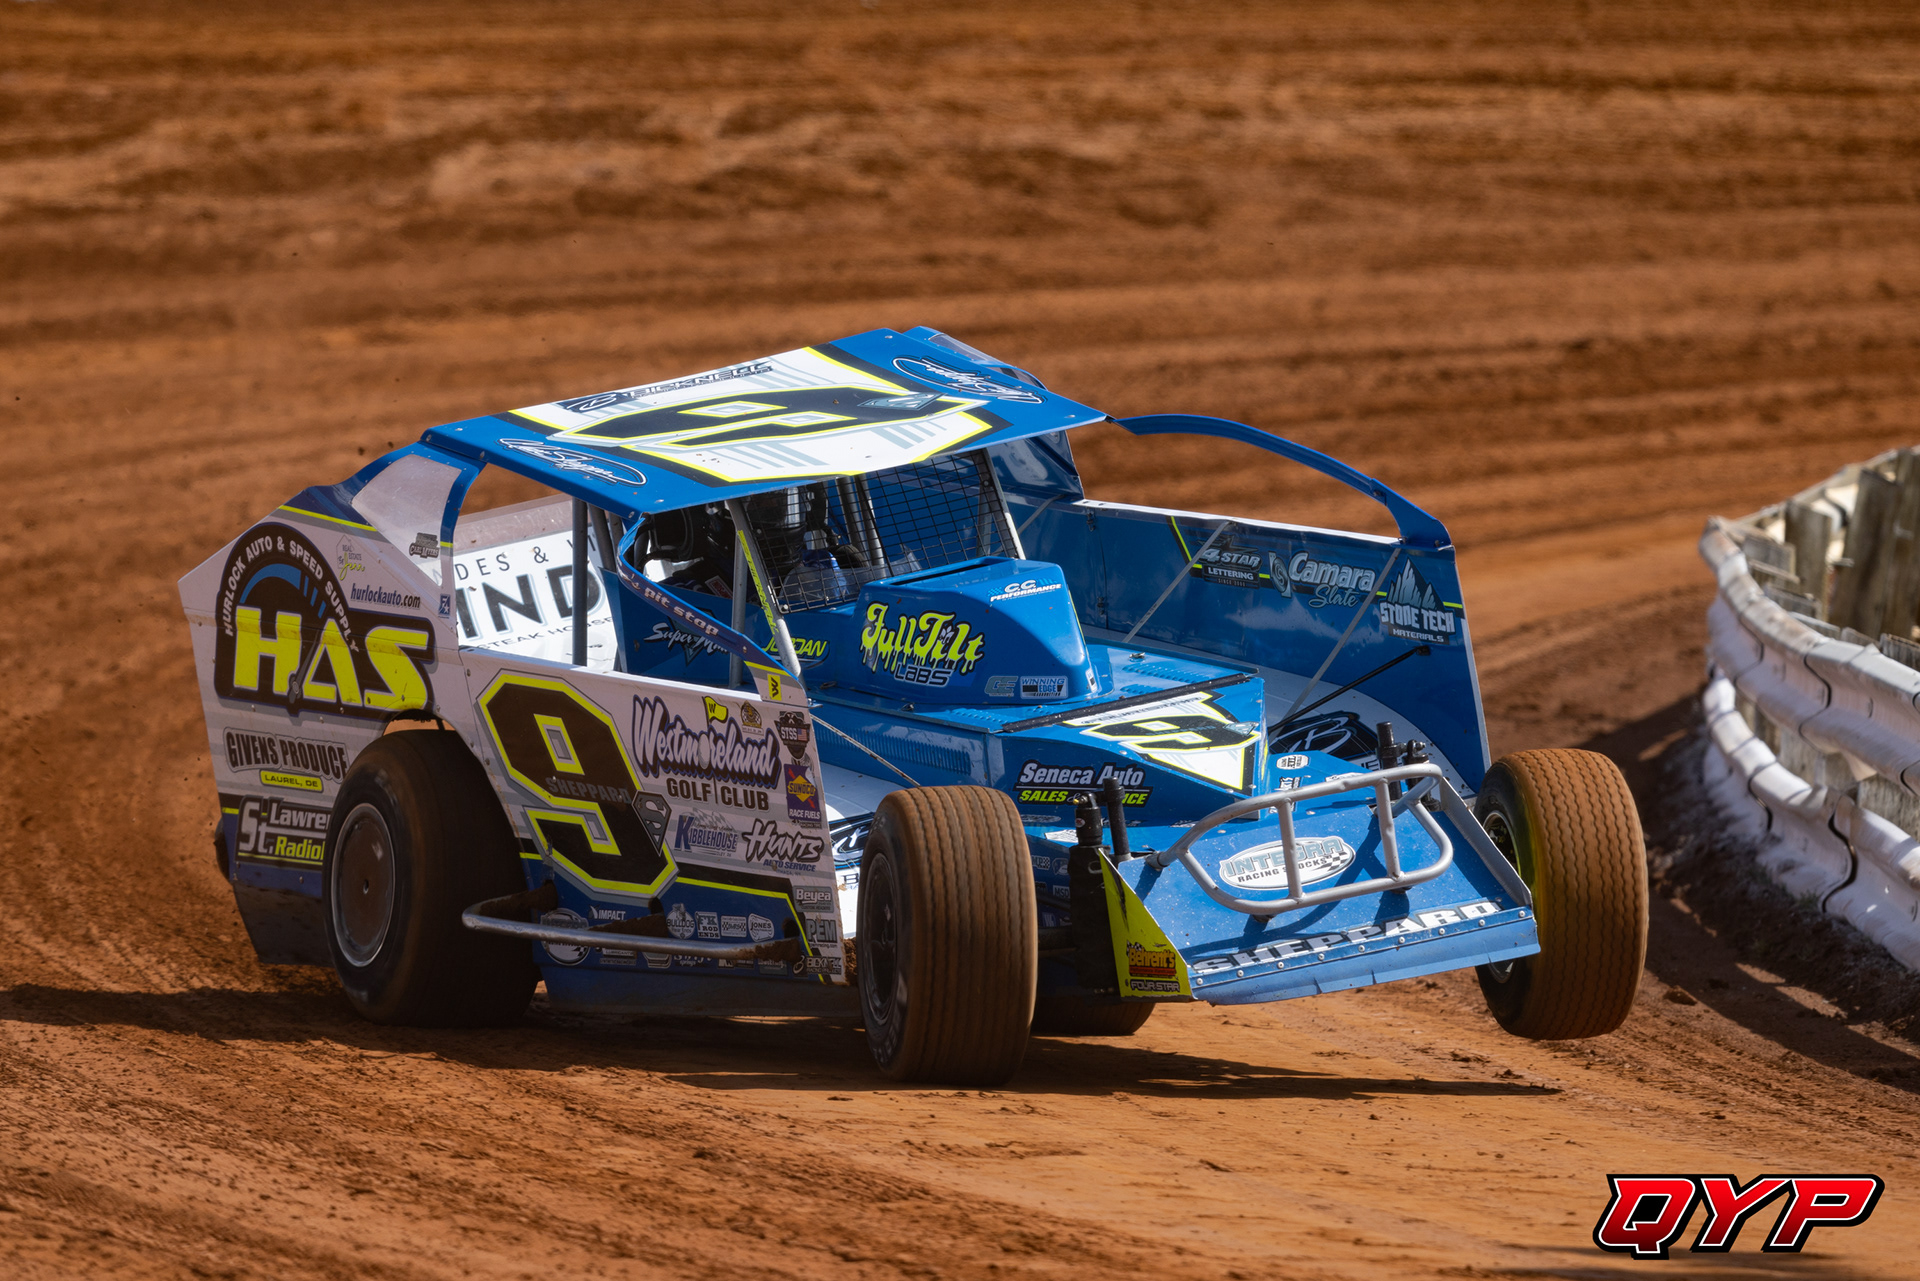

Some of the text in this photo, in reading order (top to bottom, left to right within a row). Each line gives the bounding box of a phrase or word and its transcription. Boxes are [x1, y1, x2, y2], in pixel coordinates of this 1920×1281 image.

[533, 546, 549, 564] &
[1200, 549, 1260, 568] 4 STAR
[1208, 567, 1254, 580] LETTERING
[1288, 552, 1376, 592] Camara
[223, 536, 360, 652] HURLOCK AUTO & SPEED SUPPLY
[351, 583, 421, 609] hurlockauto.com
[990, 584, 1062, 602] PERFORMANCE
[1308, 586, 1361, 609] Slate
[644, 587, 720, 637] pit stop
[1380, 602, 1456, 633] STONE TECH
[643, 622, 693, 648] Super
[1393, 629, 1444, 642] MATERIALS
[233, 606, 429, 711] HAS
[780, 727, 798, 741] STSS
[226, 732, 348, 780] GIVENS PRODUCE
[264, 774, 319, 788] LAUREL, DE
[481, 672, 680, 896] 9
[1020, 762, 1144, 786] Seneca Auto
[546, 777, 632, 805] SHEPPARD
[666, 778, 769, 811] GOLF CLUB
[788, 782, 816, 796] SUNOCO
[1020, 790, 1069, 802] SALES
[789, 809, 821, 820] RACE FUELS
[675, 815, 738, 851] KIBBLEHOUSE
[784, 861, 817, 872] SERVICE
[1237, 857, 1328, 883] RACING SOCKS
[796, 888, 832, 904] Beyea
[599, 910, 627, 921] IMPACT
[666, 919, 696, 928] BULLDOG
[699, 916, 718, 926] FK
[750, 922, 772, 931] JONES
[806, 919, 838, 943] PEM
[1192, 900, 1502, 974] SHEPPARD
[1129, 947, 1176, 968] Behrent's
[1131, 980, 1181, 993] FOUR STAR
